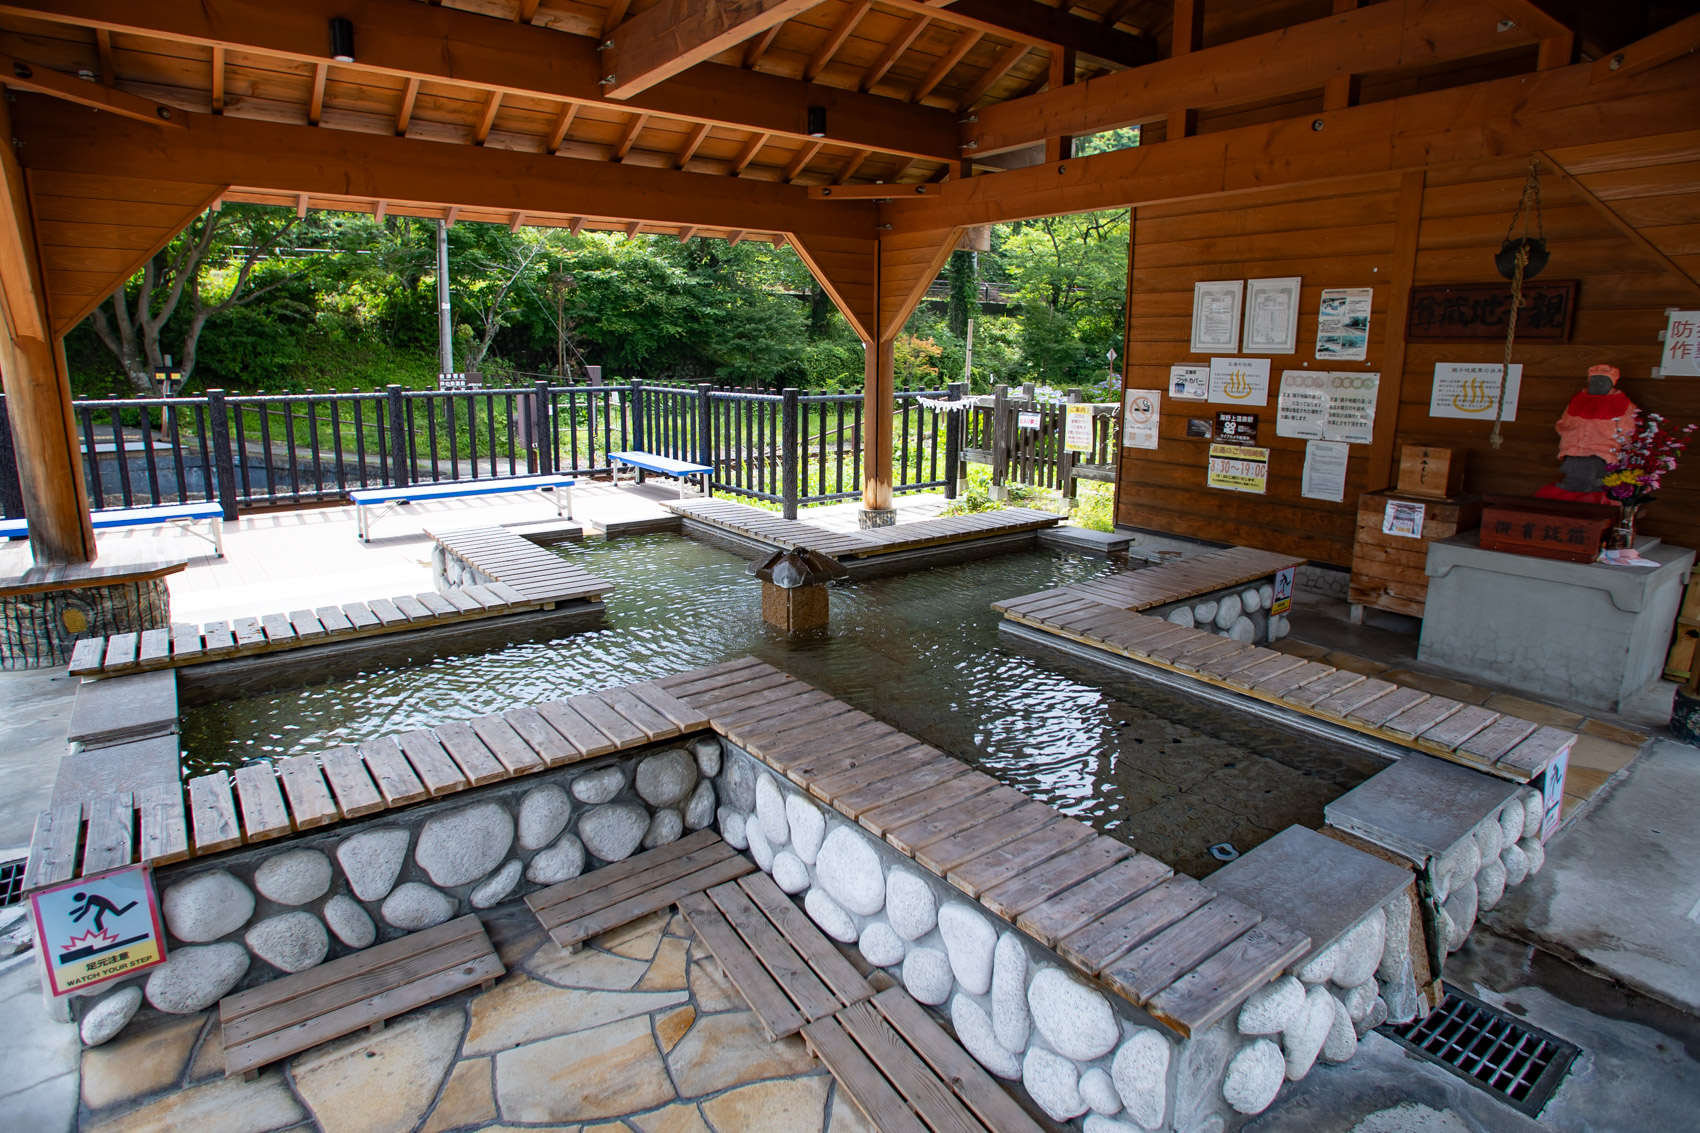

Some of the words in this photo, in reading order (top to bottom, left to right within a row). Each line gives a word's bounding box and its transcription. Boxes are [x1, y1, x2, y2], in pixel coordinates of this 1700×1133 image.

[1176, 377, 1204, 385] フットカバー
[1285, 375, 1325, 389] お客様へ
[1332, 376, 1375, 390] お客様へ
[86, 952, 130, 971] 足元注意
[67, 971, 101, 987] WATCH
[102, 963, 129, 976] YOUR
[130, 955, 153, 967] STEP
